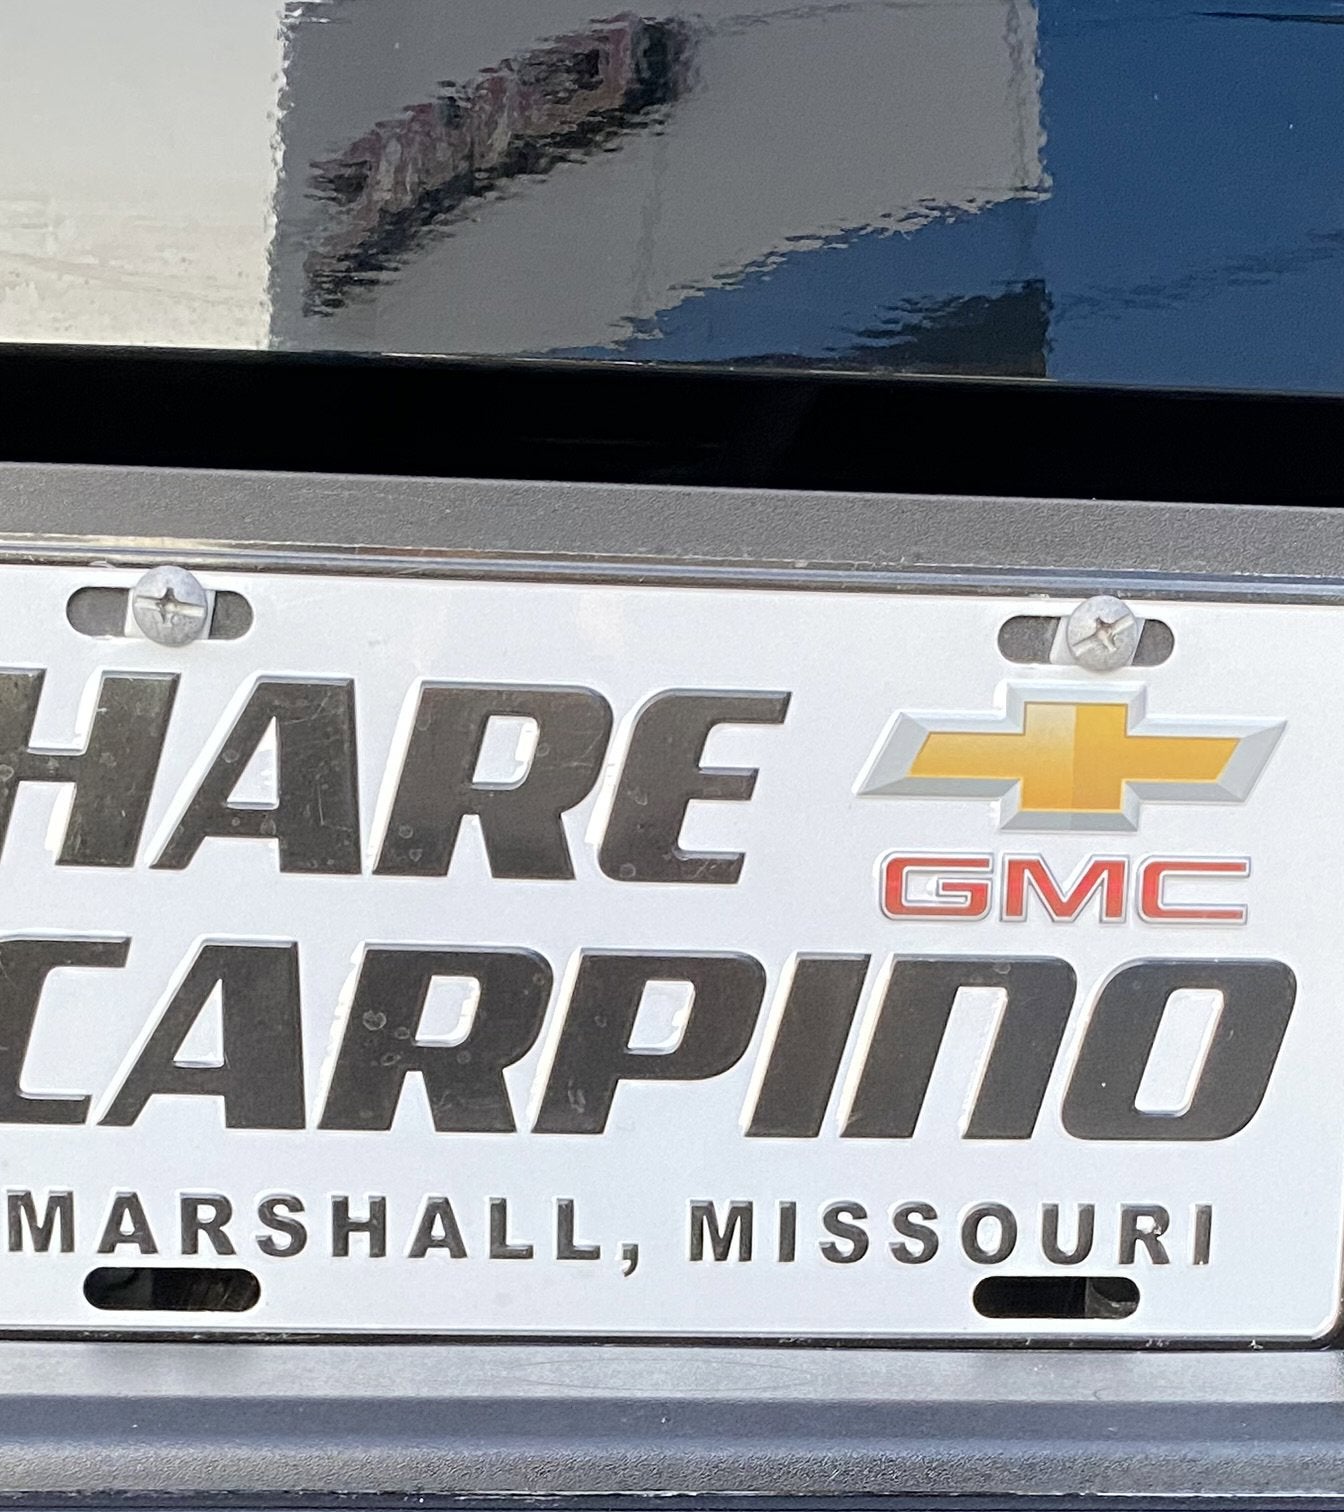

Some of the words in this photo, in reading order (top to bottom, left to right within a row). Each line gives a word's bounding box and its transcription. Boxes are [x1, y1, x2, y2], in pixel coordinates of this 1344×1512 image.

[880, 852, 1250, 923] GMC
[6, 1190, 640, 1277] MARSHALL,
[689, 1200, 1214, 1265] MISSOURI
